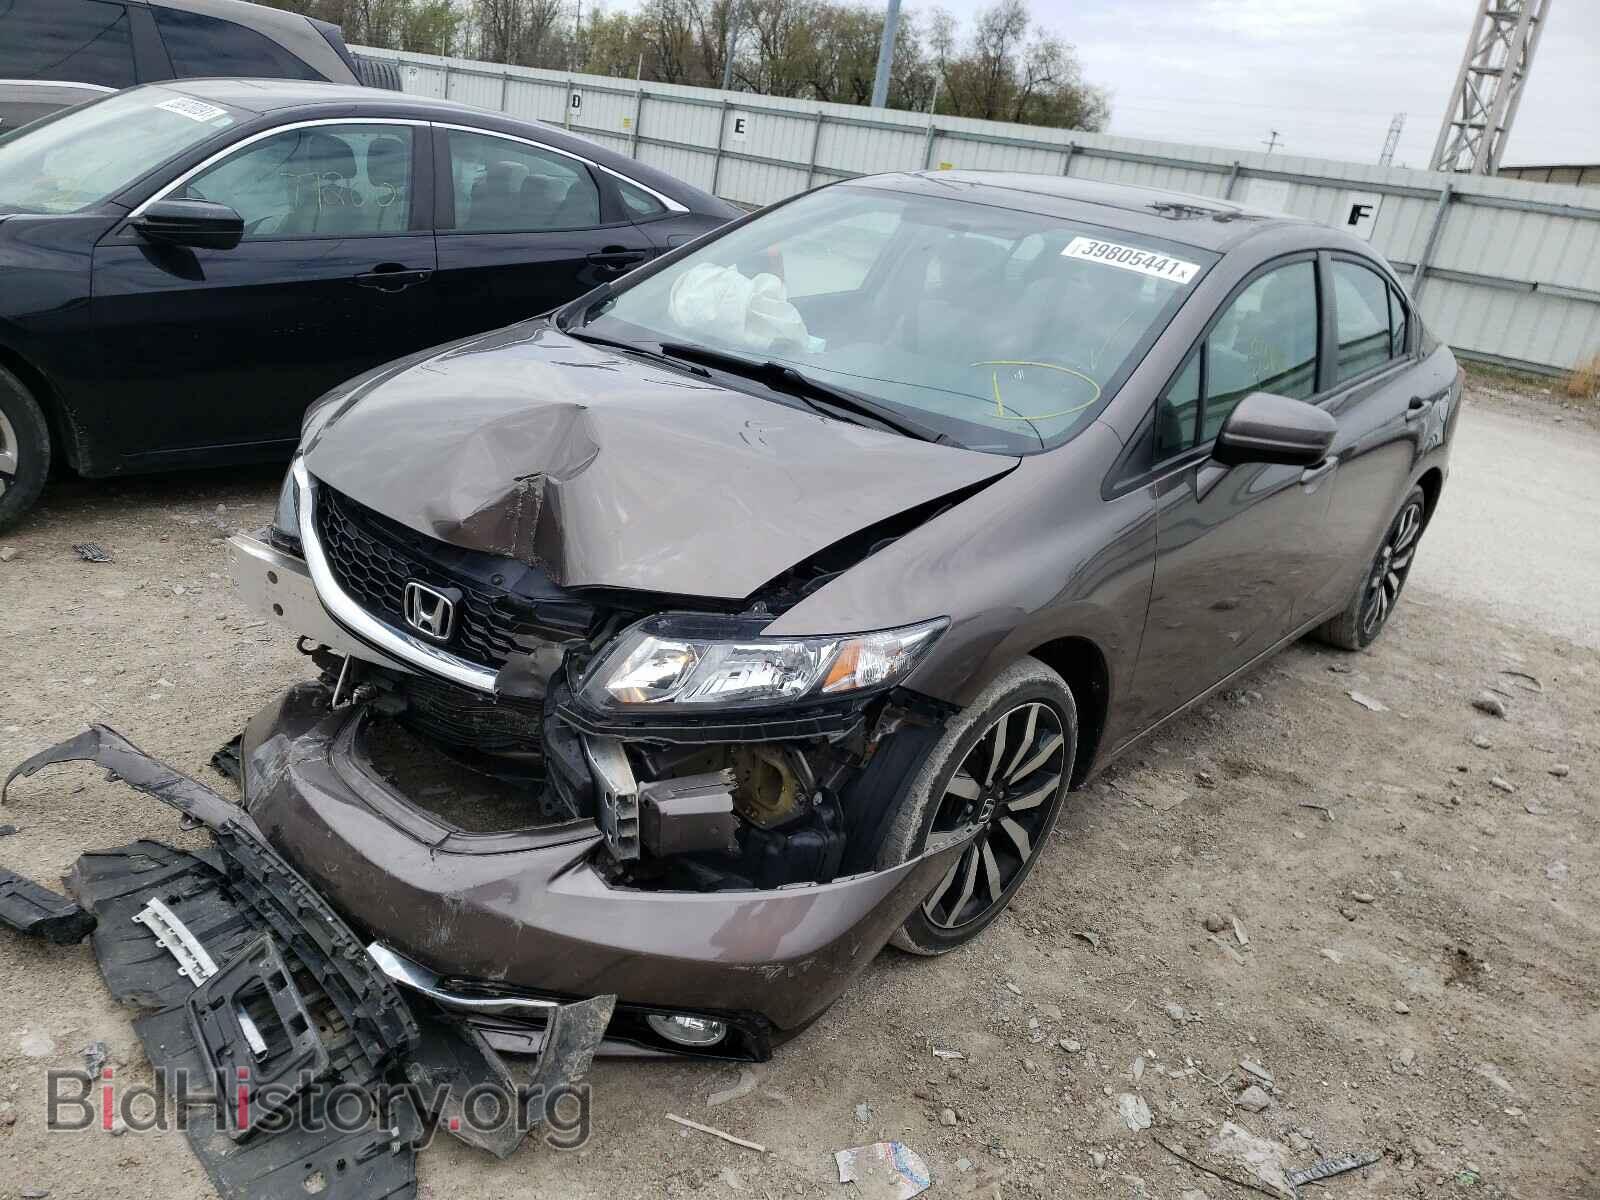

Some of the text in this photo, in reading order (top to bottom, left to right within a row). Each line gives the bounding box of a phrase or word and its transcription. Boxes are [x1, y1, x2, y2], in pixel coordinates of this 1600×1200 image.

[571, 94, 581, 109] D
[734, 118, 746, 134] E
[1347, 204, 1373, 225] F
[1081, 241, 1179, 275] 39805441
